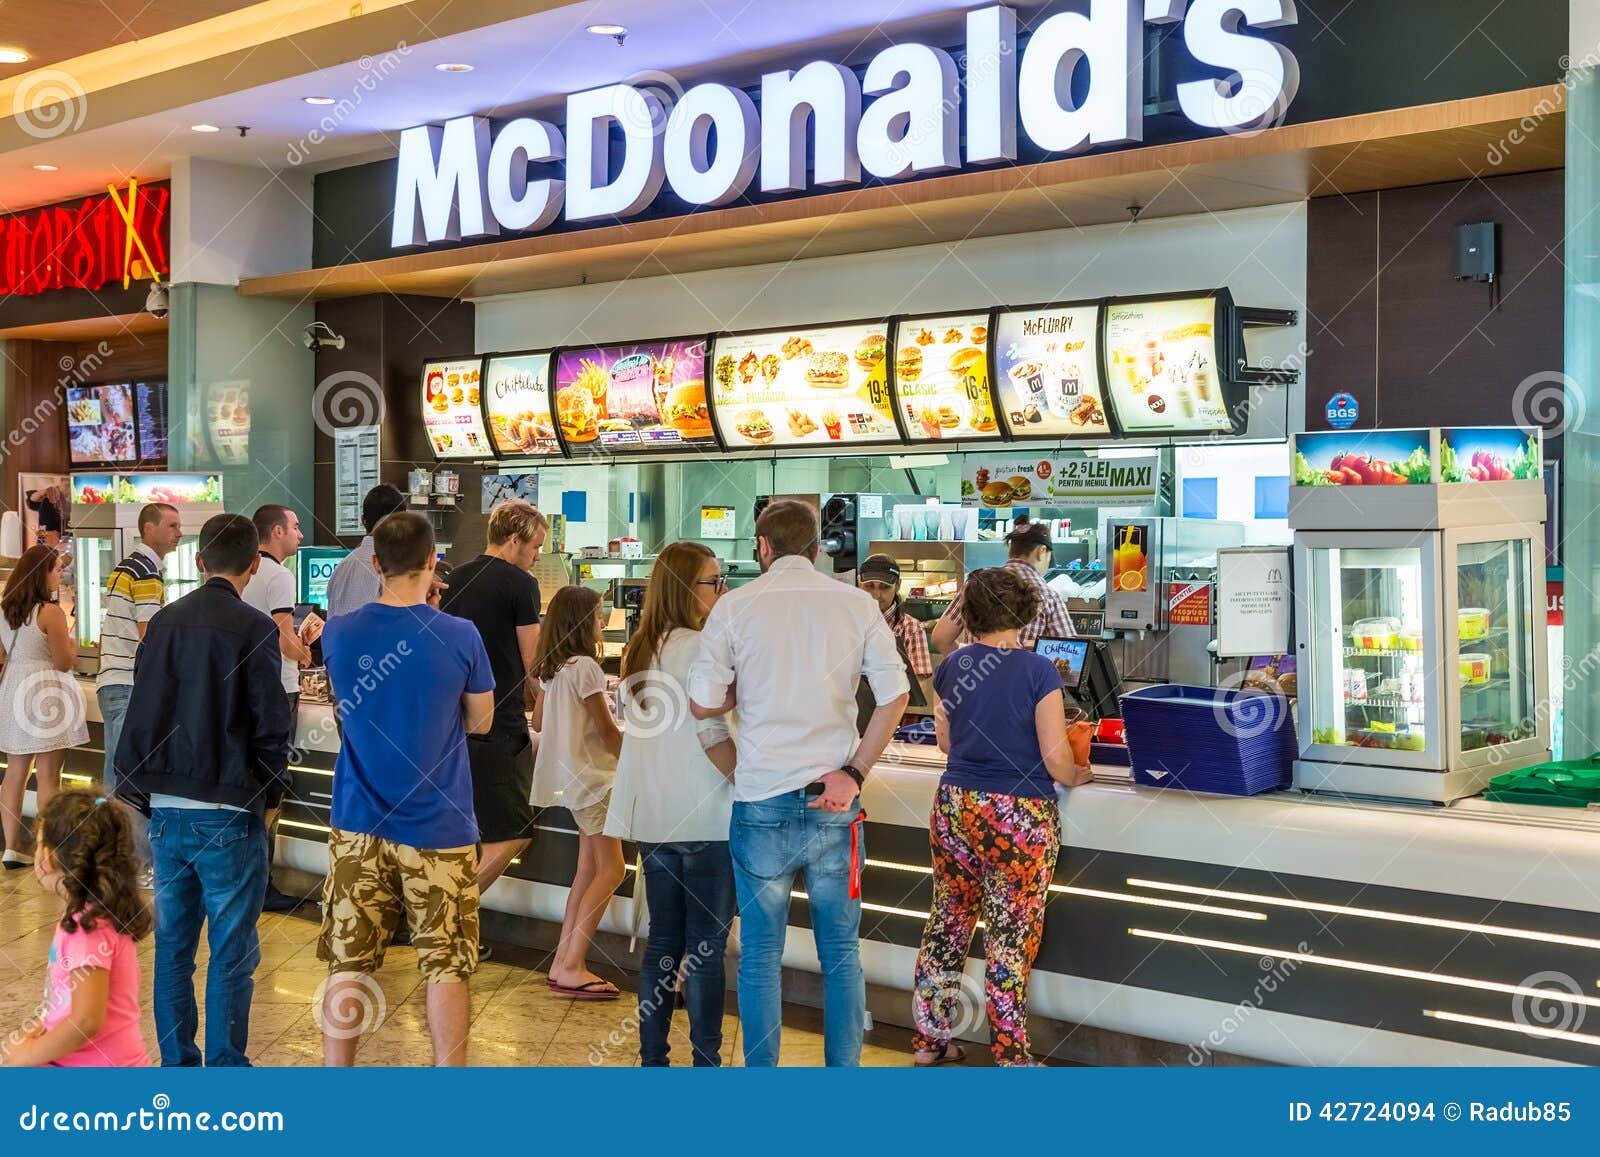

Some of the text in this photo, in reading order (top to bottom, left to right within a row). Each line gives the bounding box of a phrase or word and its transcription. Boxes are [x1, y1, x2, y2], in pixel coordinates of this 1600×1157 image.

[1327, 408, 1357, 418] BGS
[1017, 465, 1034, 473] fresh
[1088, 461, 1110, 478] LEI
[1109, 466, 1152, 487] MAXI
[1058, 479, 1082, 487] PENTRU
